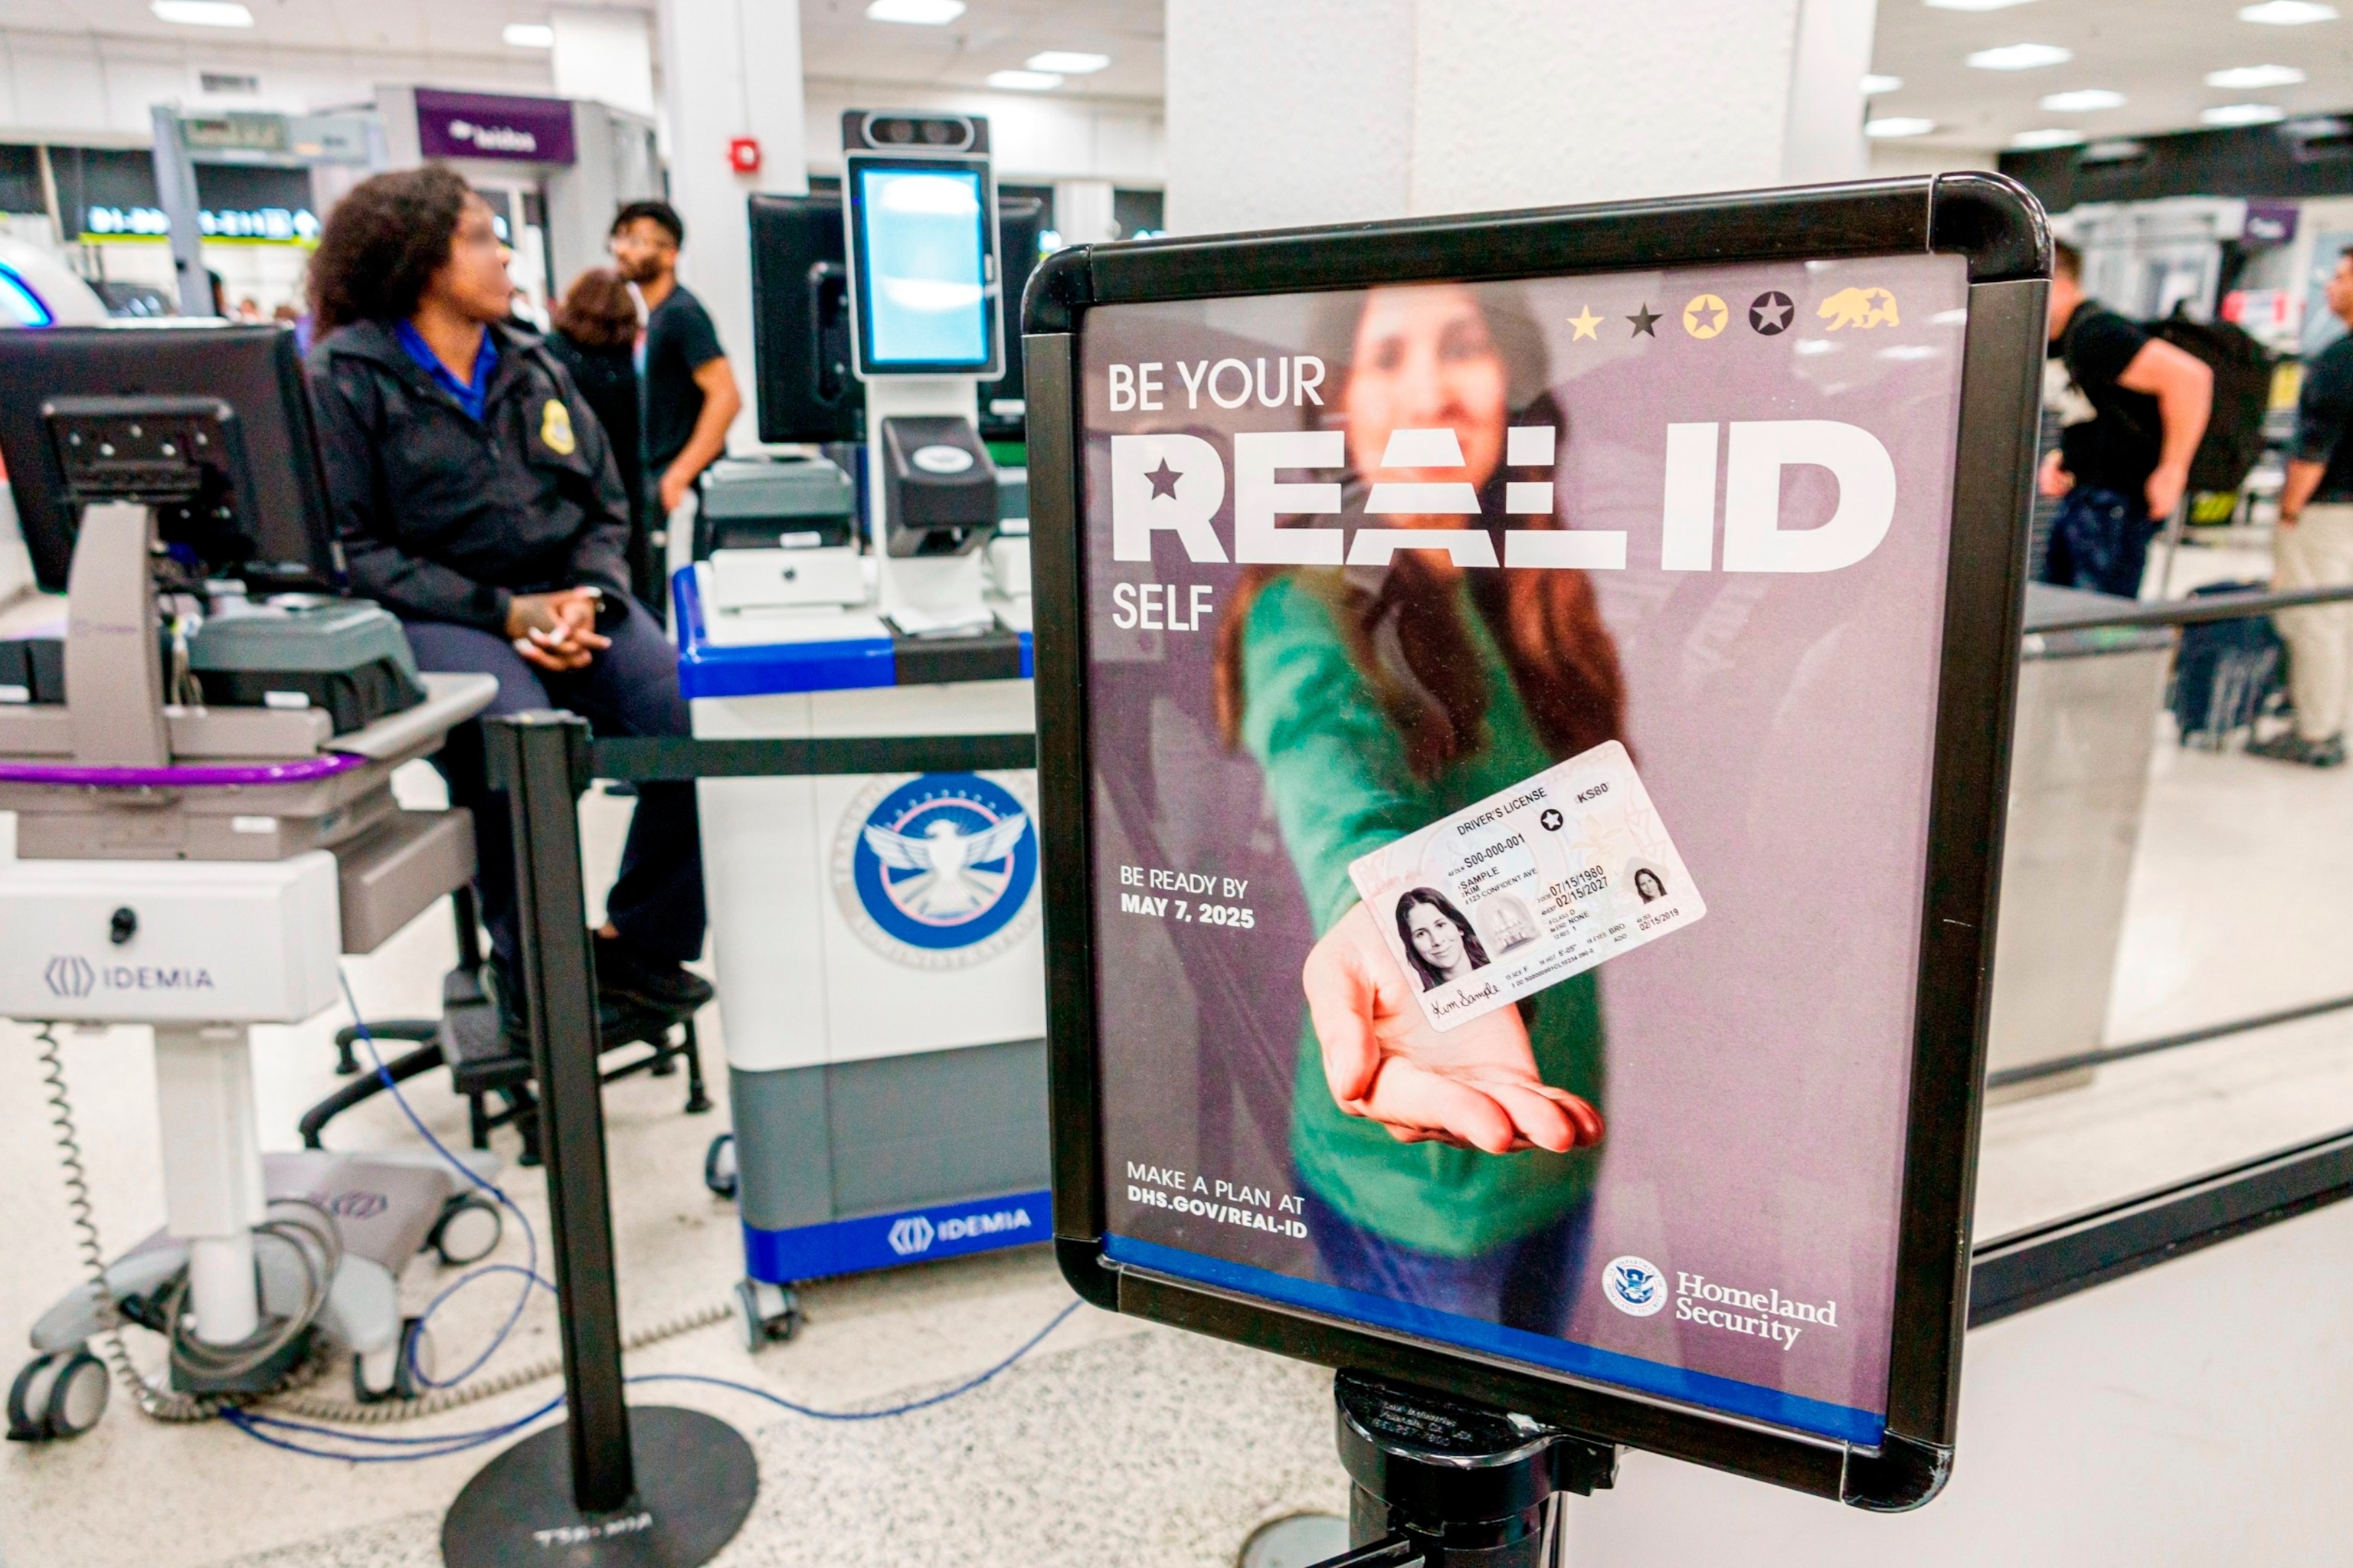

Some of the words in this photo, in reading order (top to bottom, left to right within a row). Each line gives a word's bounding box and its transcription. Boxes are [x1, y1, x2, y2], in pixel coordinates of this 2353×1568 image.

[1109, 362, 1163, 411] BE
[1176, 355, 1325, 409] YOUR
[1111, 425, 1628, 568] REAL
[1661, 419, 1896, 572] ID
[1113, 582, 1212, 631] SELF
[1457, 807, 1503, 835] DRIVER'S
[1504, 787, 1546, 813] LICENSE
[1464, 833, 1524, 867] S00-000-001
[1121, 865, 1144, 887] BE
[1150, 869, 1217, 895] READY
[1223, 878, 1248, 899] BY
[1460, 866, 1499, 889] SAMPLE
[1463, 884, 1480, 896] KIM
[1468, 893, 1481, 902] 123
[1481, 875, 1520, 896] CONFIDENT
[1523, 867, 1537, 878] AVE
[1550, 865, 1603, 895] 07/15/1980
[1556, 876, 1607, 907] 02/15/2027
[1121, 893, 1168, 917] MAY
[1174, 899, 1193, 922] 7,
[1199, 903, 1255, 928] 2025
[1567, 912, 1589, 924] NONE
[1639, 908, 1678, 930] 02/15/2019
[1608, 922, 1625, 935] BRO
[103, 964, 215, 990] IDEMIA
[1431, 1001, 1459, 1018] Kim
[1457, 982, 1500, 1006] Sample
[1127, 1161, 1186, 1190] MAKE
[1193, 1176, 1209, 1195] A
[1216, 1180, 1271, 1208] PLAN
[1278, 1194, 1306, 1215] AT
[938, 1208, 1032, 1242] IDEMIA
[1127, 1185, 1308, 1239] DHS.GOV/REAL-ID
[1676, 1272, 1838, 1327] Homeland
[1676, 1297, 1802, 1350] Security
